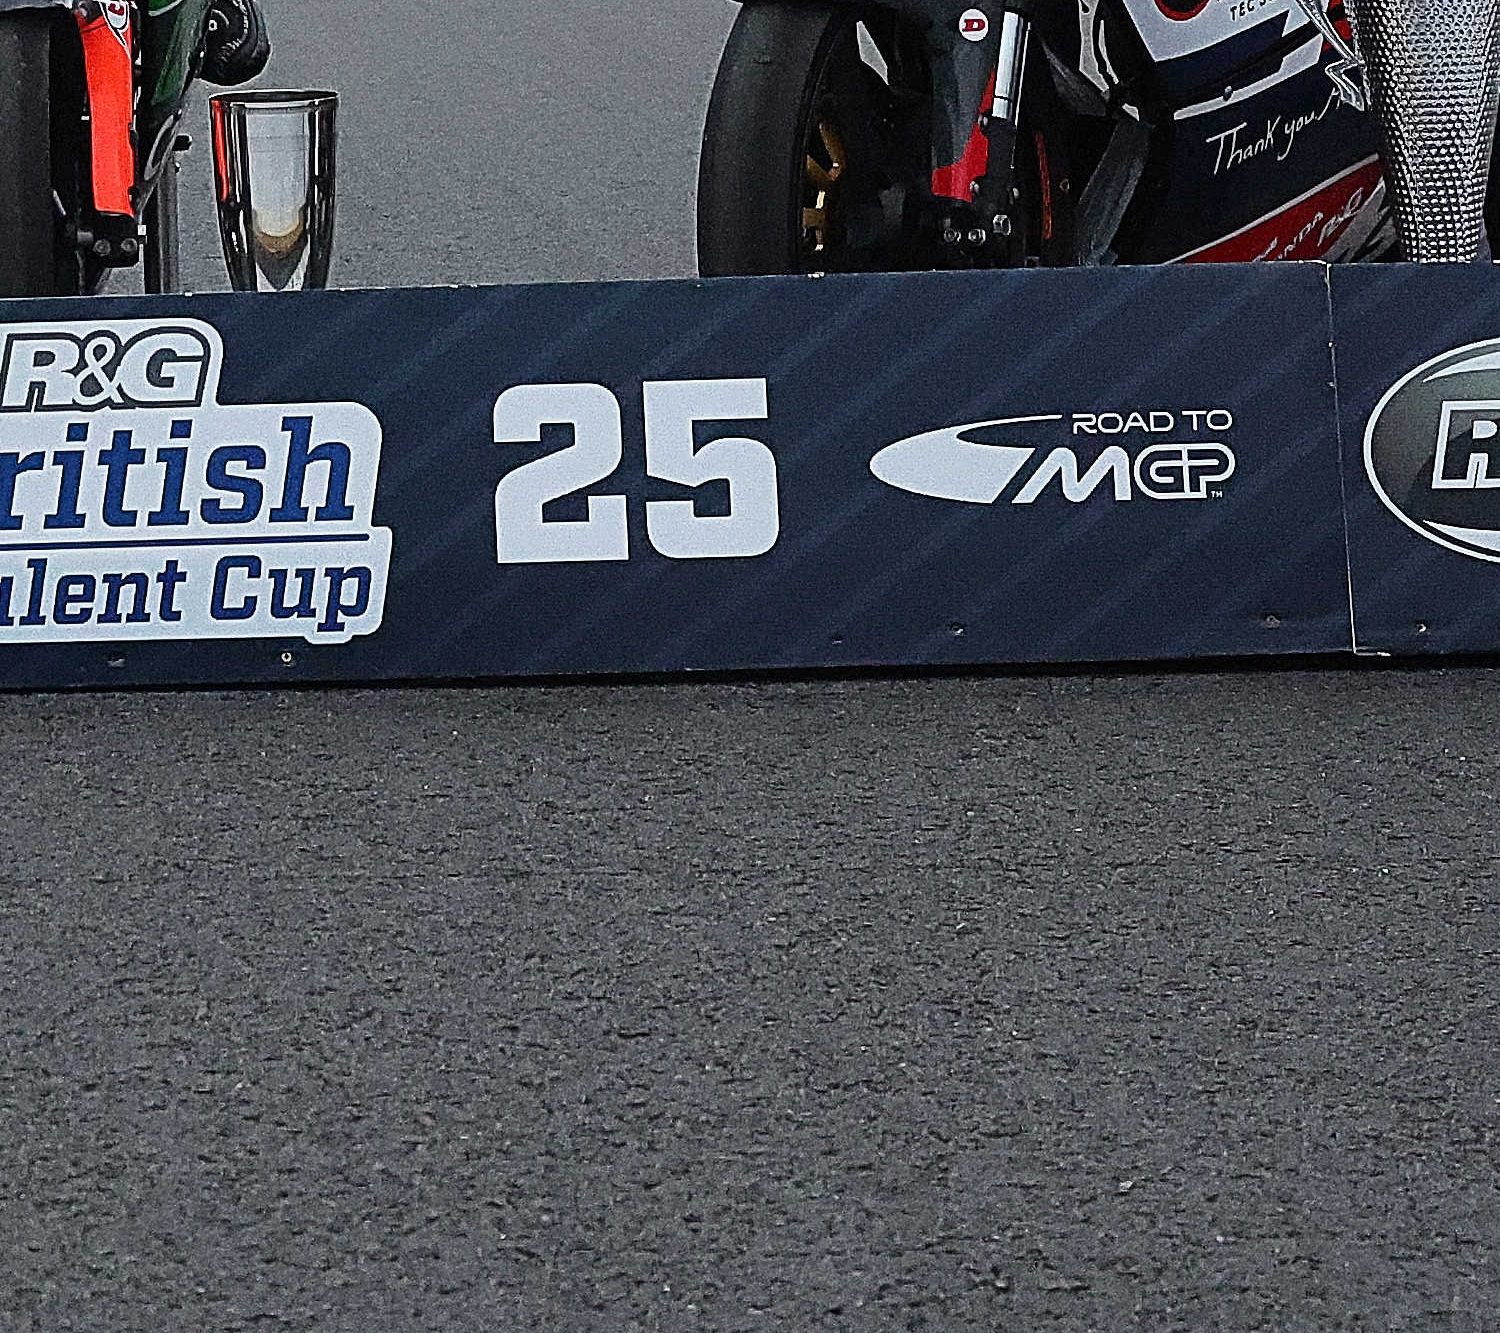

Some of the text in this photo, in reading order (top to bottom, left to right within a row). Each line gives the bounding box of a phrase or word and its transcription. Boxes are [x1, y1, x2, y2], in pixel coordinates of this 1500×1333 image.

[961, 18, 986, 32] D
[0, 327, 209, 411] R&G
[1072, 409, 1234, 434] ROAD TO
[493, 378, 779, 564] 25
[210, 554, 373, 632] Cup
